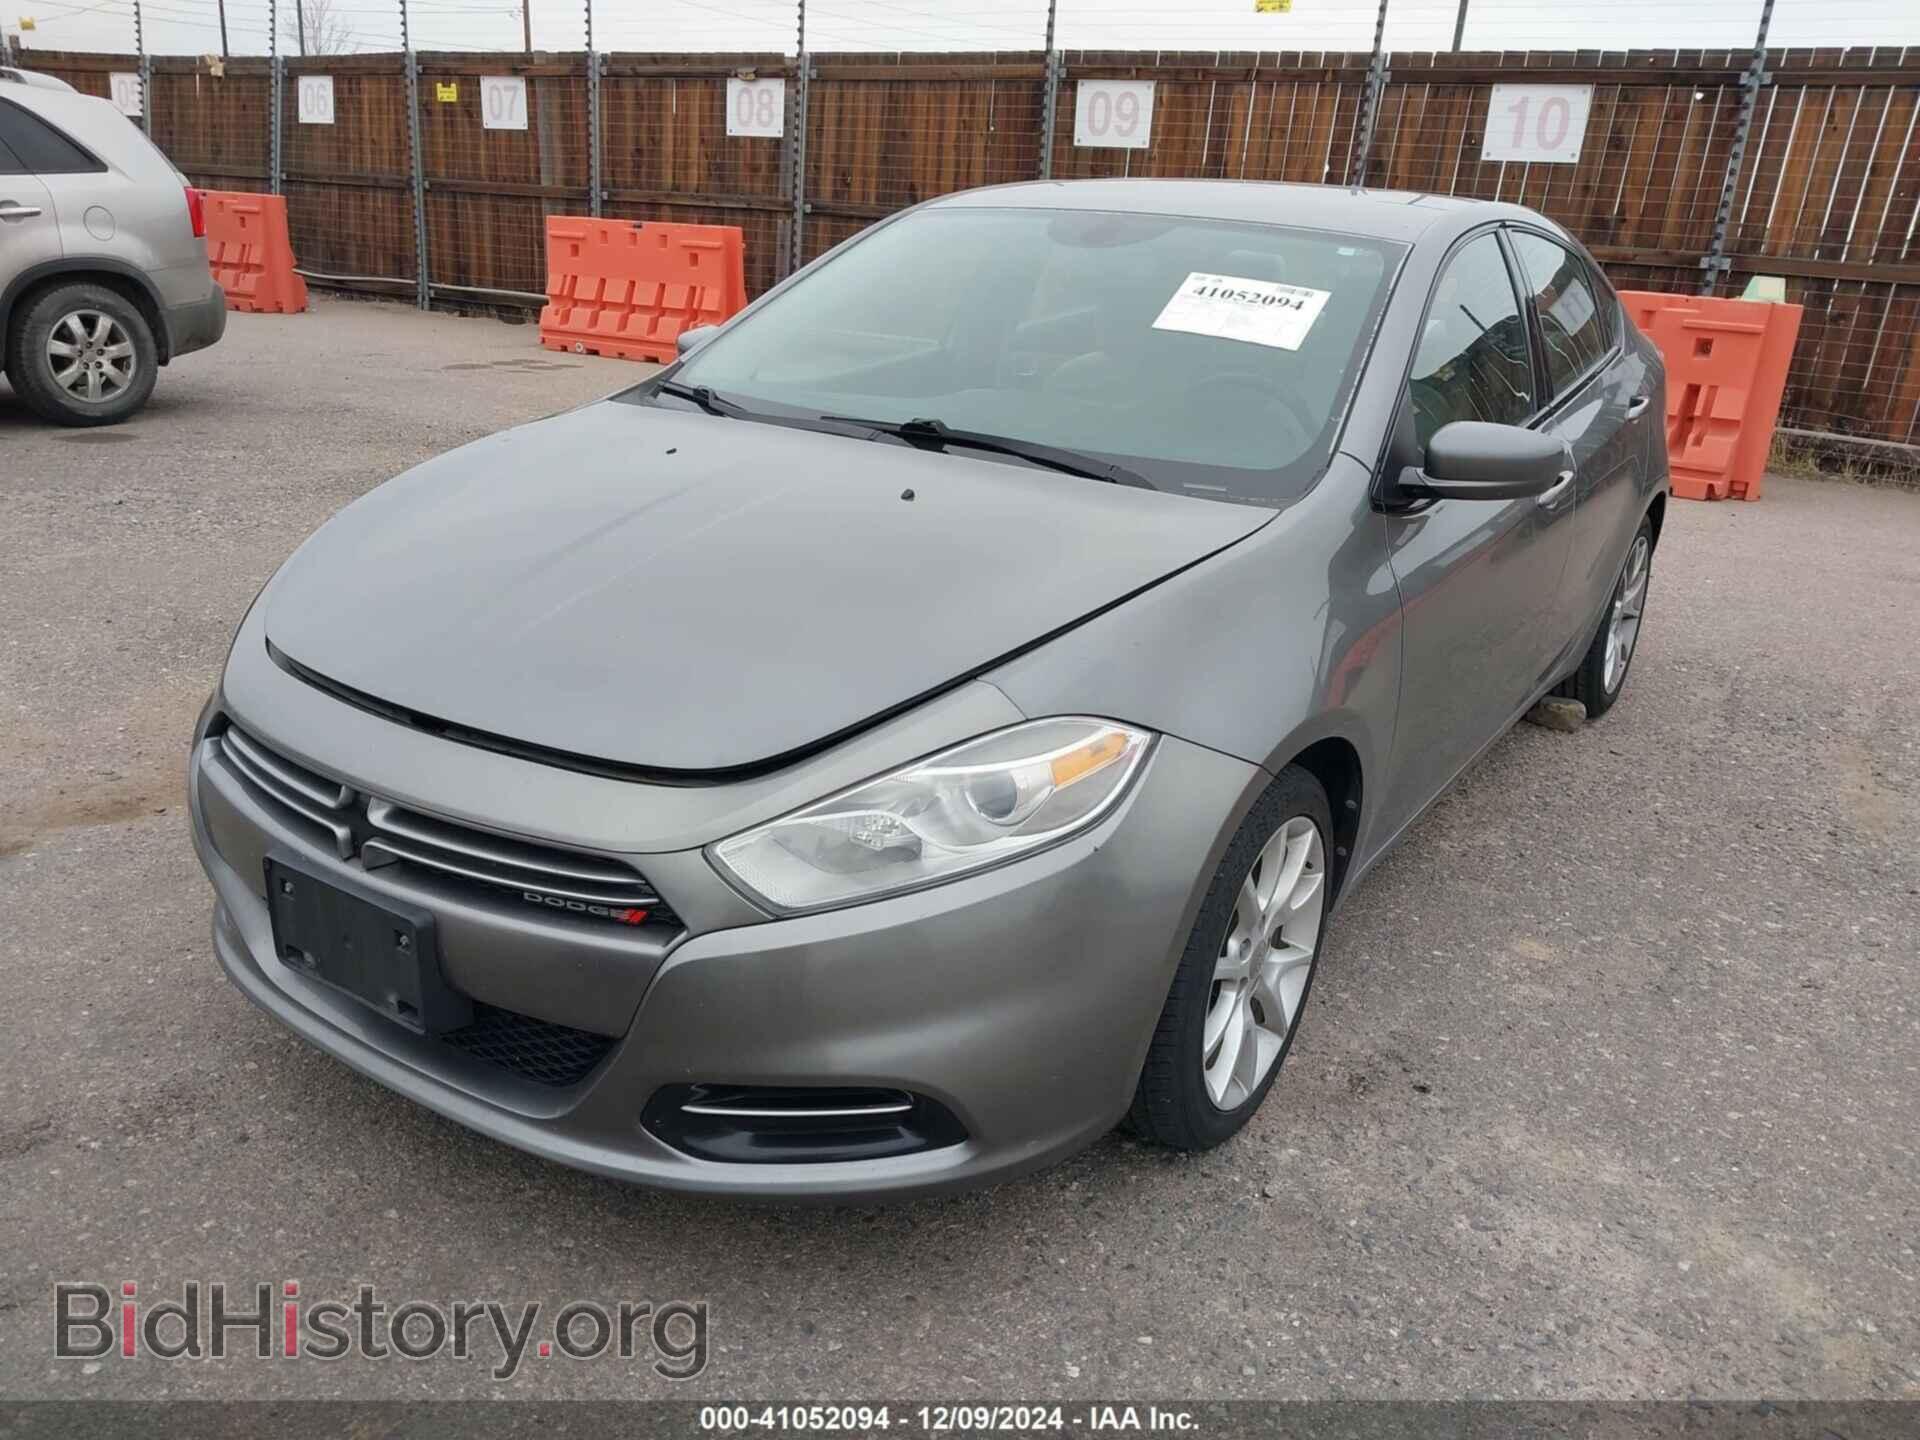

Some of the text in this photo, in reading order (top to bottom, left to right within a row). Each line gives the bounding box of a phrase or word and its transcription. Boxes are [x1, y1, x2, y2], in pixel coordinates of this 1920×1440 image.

[303, 83, 328, 116] 06
[489, 84, 519, 121] 07
[736, 87, 775, 128] 08
[1088, 90, 1140, 137] 09
[1508, 96, 1570, 151] 10
[1192, 285, 1305, 311] 41052094
[523, 892, 629, 920] DODGE
